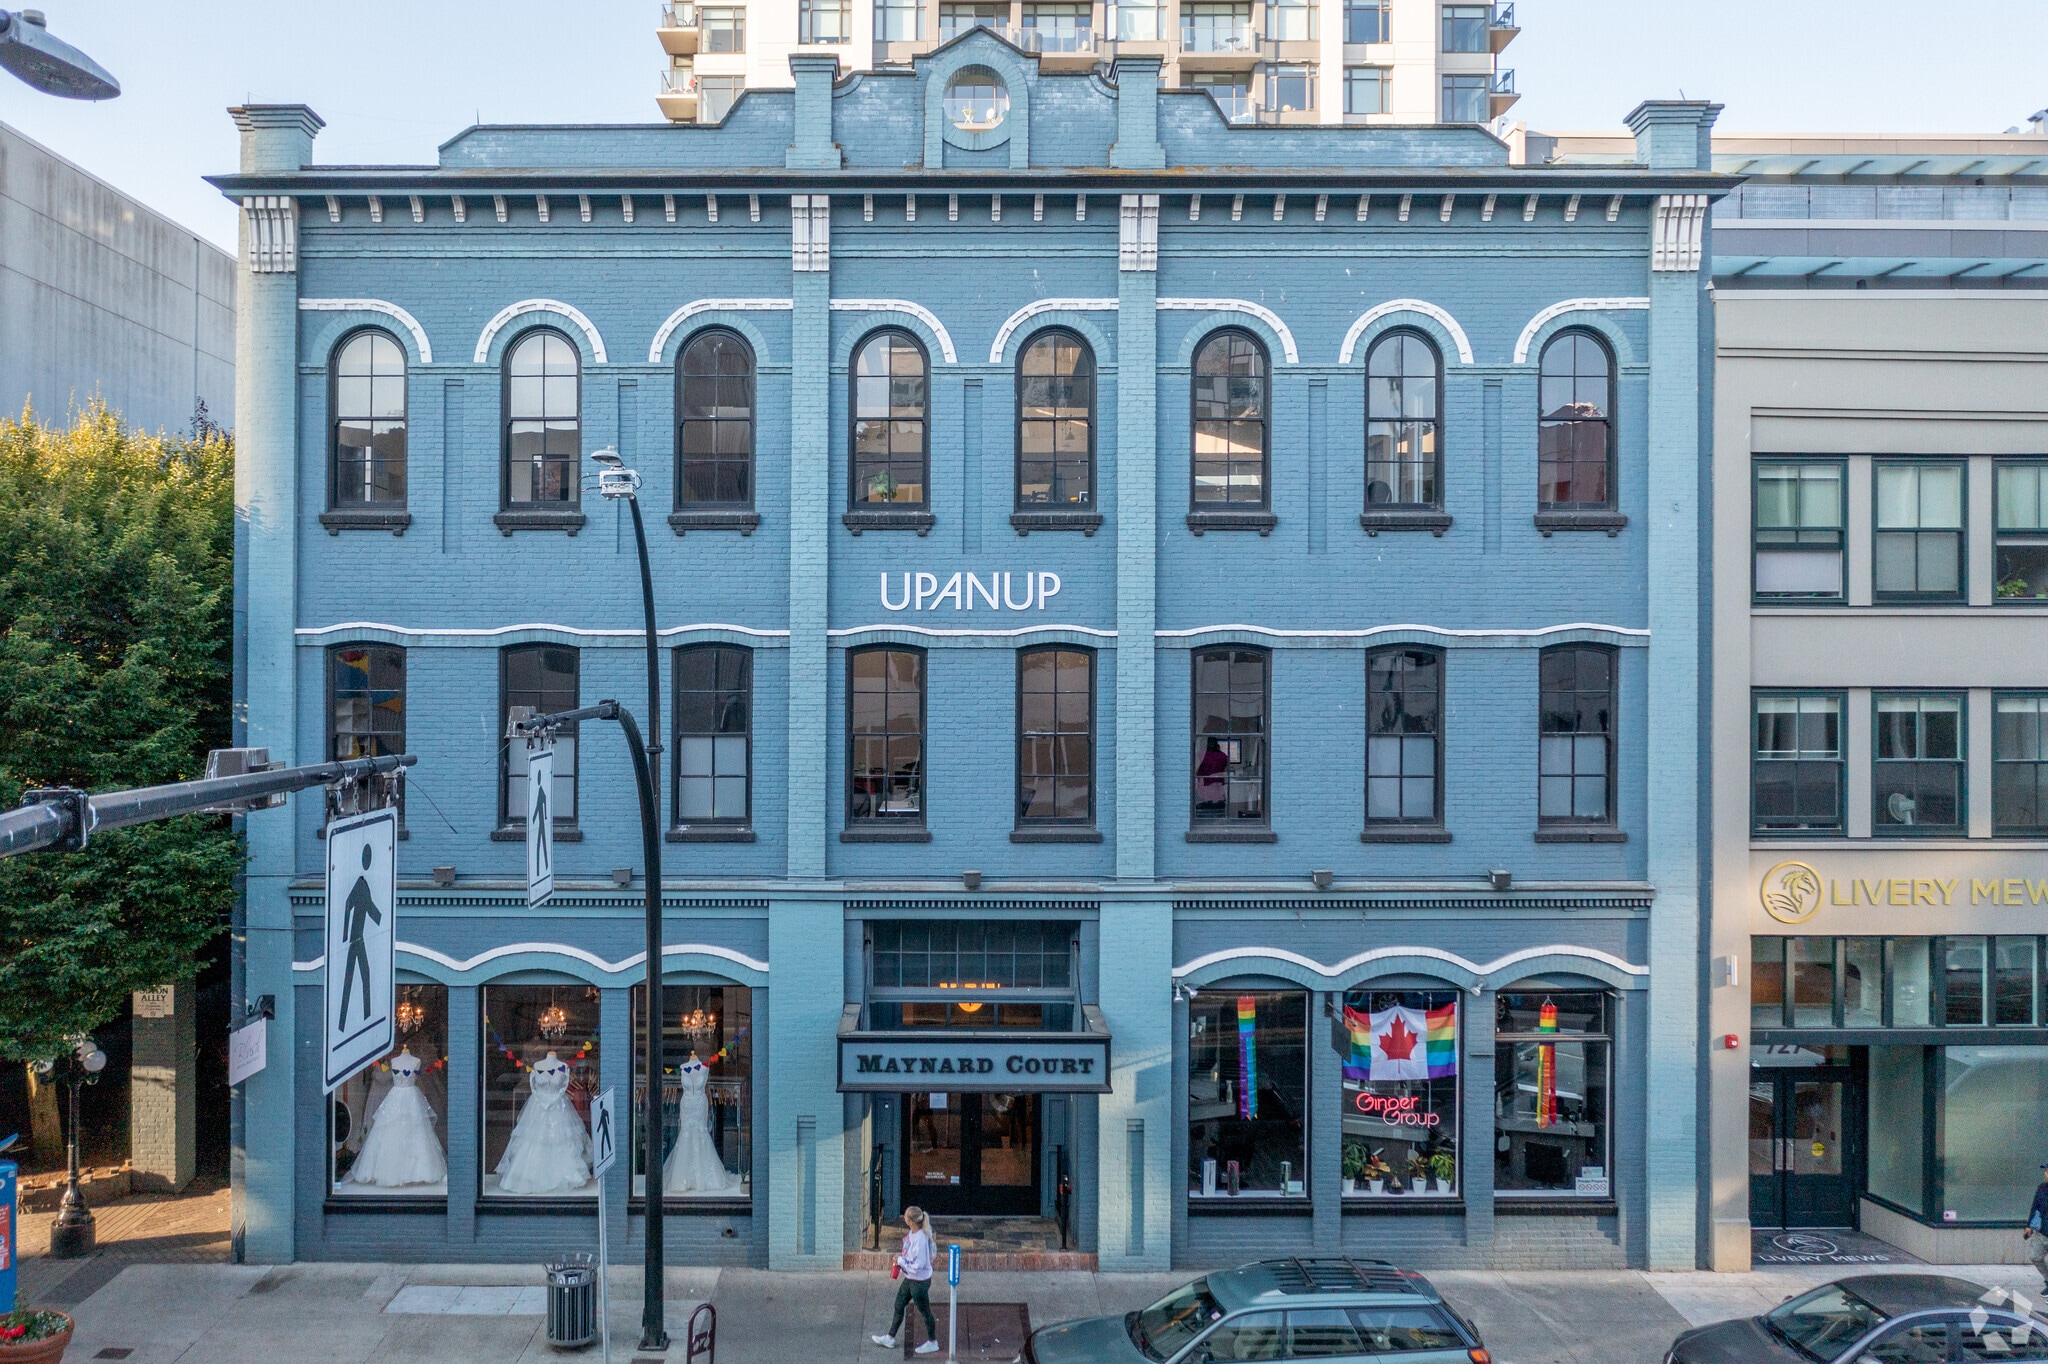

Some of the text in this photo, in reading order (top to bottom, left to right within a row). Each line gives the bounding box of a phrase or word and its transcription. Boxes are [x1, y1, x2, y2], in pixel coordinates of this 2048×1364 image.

[881, 572, 1061, 610] UPANUP
[1832, 879, 1960, 905] LIVERY
[857, 1054, 1094, 1073] MAYNARD COURT
[1356, 1092, 1419, 1112] Ginger
[1383, 1107, 1440, 1128] Group
